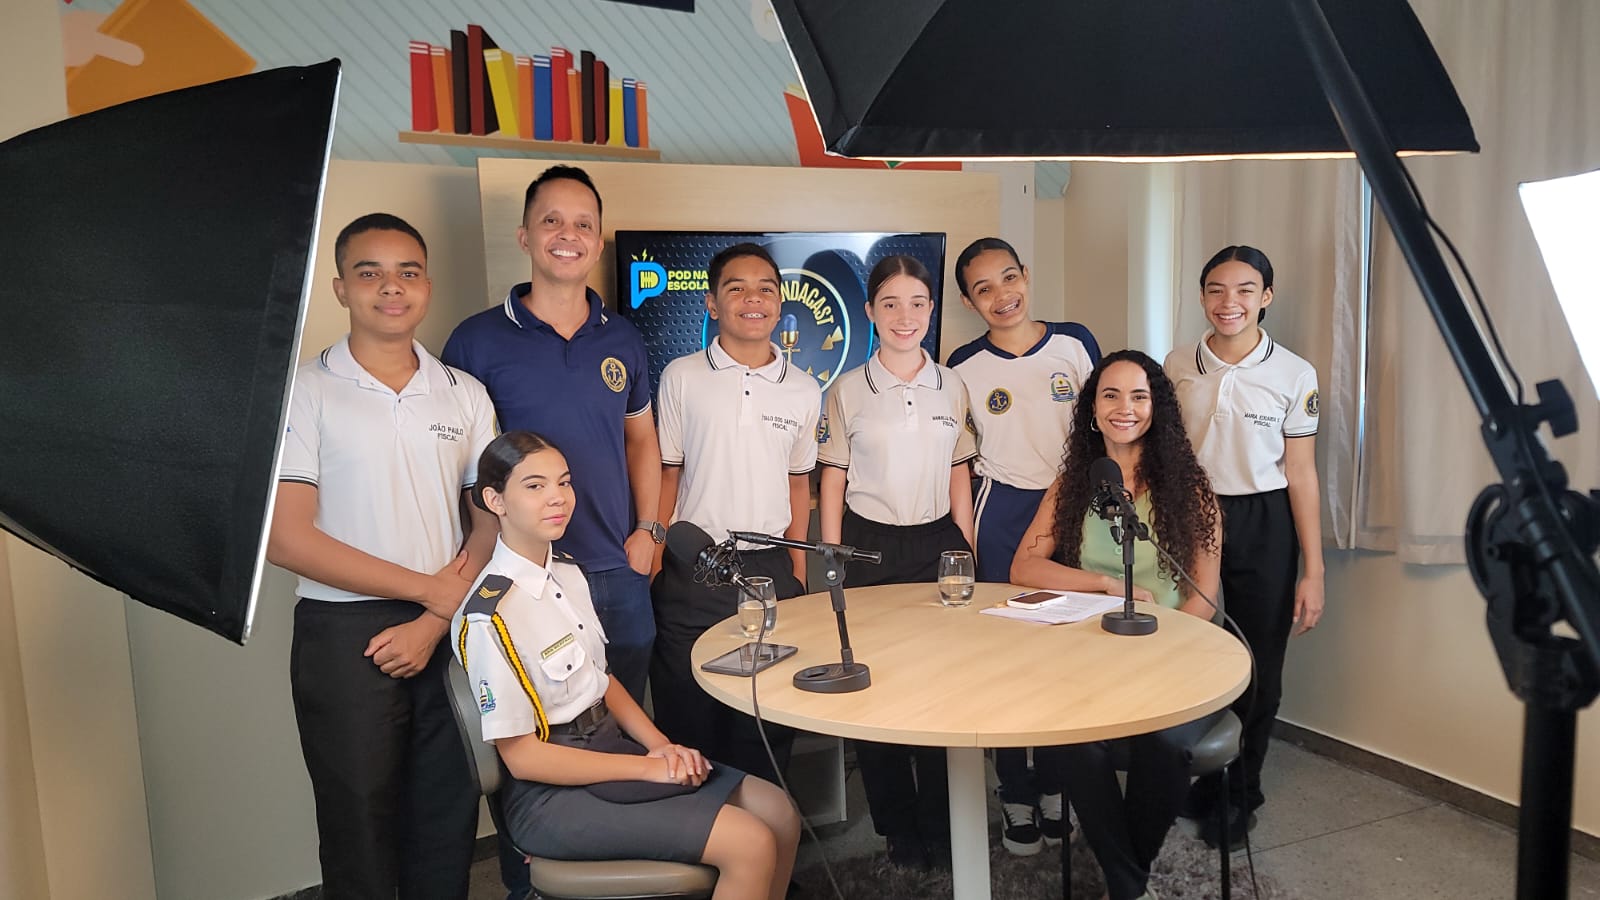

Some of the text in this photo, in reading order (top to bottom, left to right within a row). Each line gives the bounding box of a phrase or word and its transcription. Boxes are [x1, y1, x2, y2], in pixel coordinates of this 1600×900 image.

[668, 270, 709, 280] POD NA
[667, 281, 709, 291] ESCOLA
[780, 280, 834, 326] NDACAST
[429, 422, 464, 436] JOÃO PAULO
[437, 432, 458, 441] FISCAL
